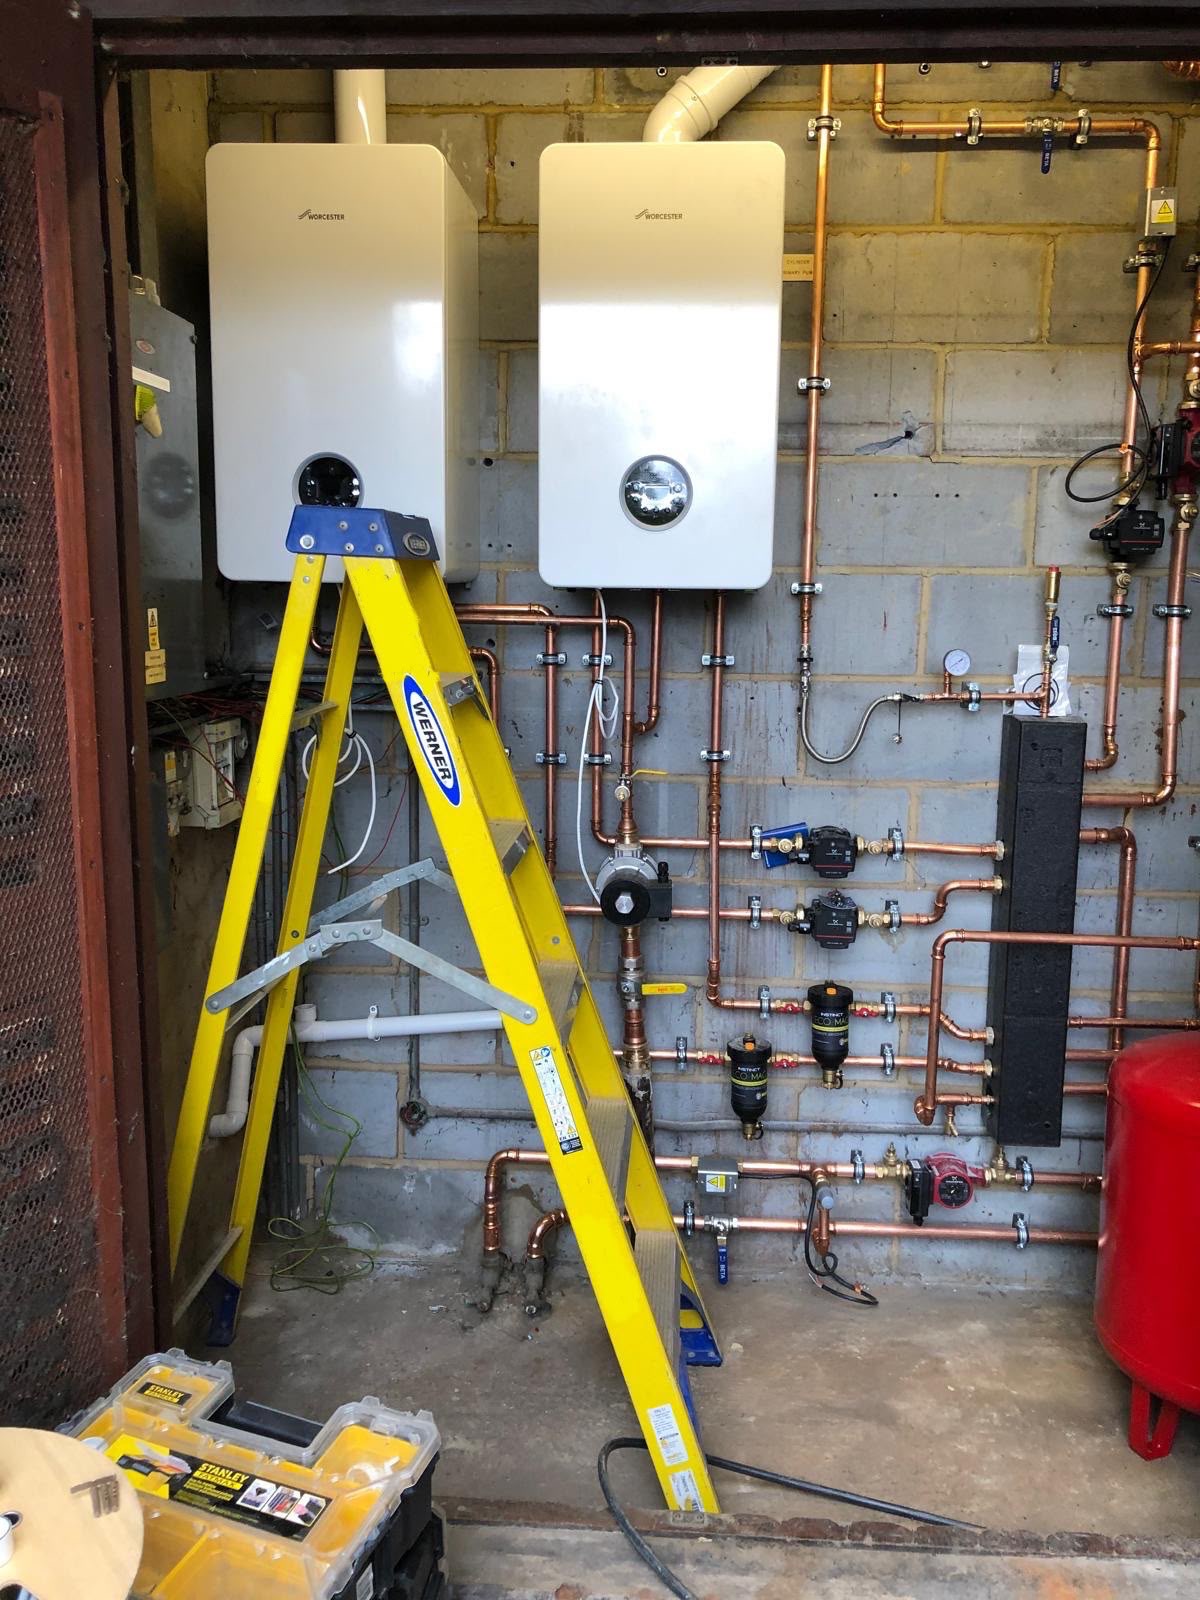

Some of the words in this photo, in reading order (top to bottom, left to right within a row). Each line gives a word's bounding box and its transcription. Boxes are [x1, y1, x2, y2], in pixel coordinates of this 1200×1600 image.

[412, 701, 452, 780] WERNER
[149, 1384, 185, 1399] STANLEY
[199, 1463, 250, 1483] STANLEY
[199, 1472, 236, 1488] FATMAX
